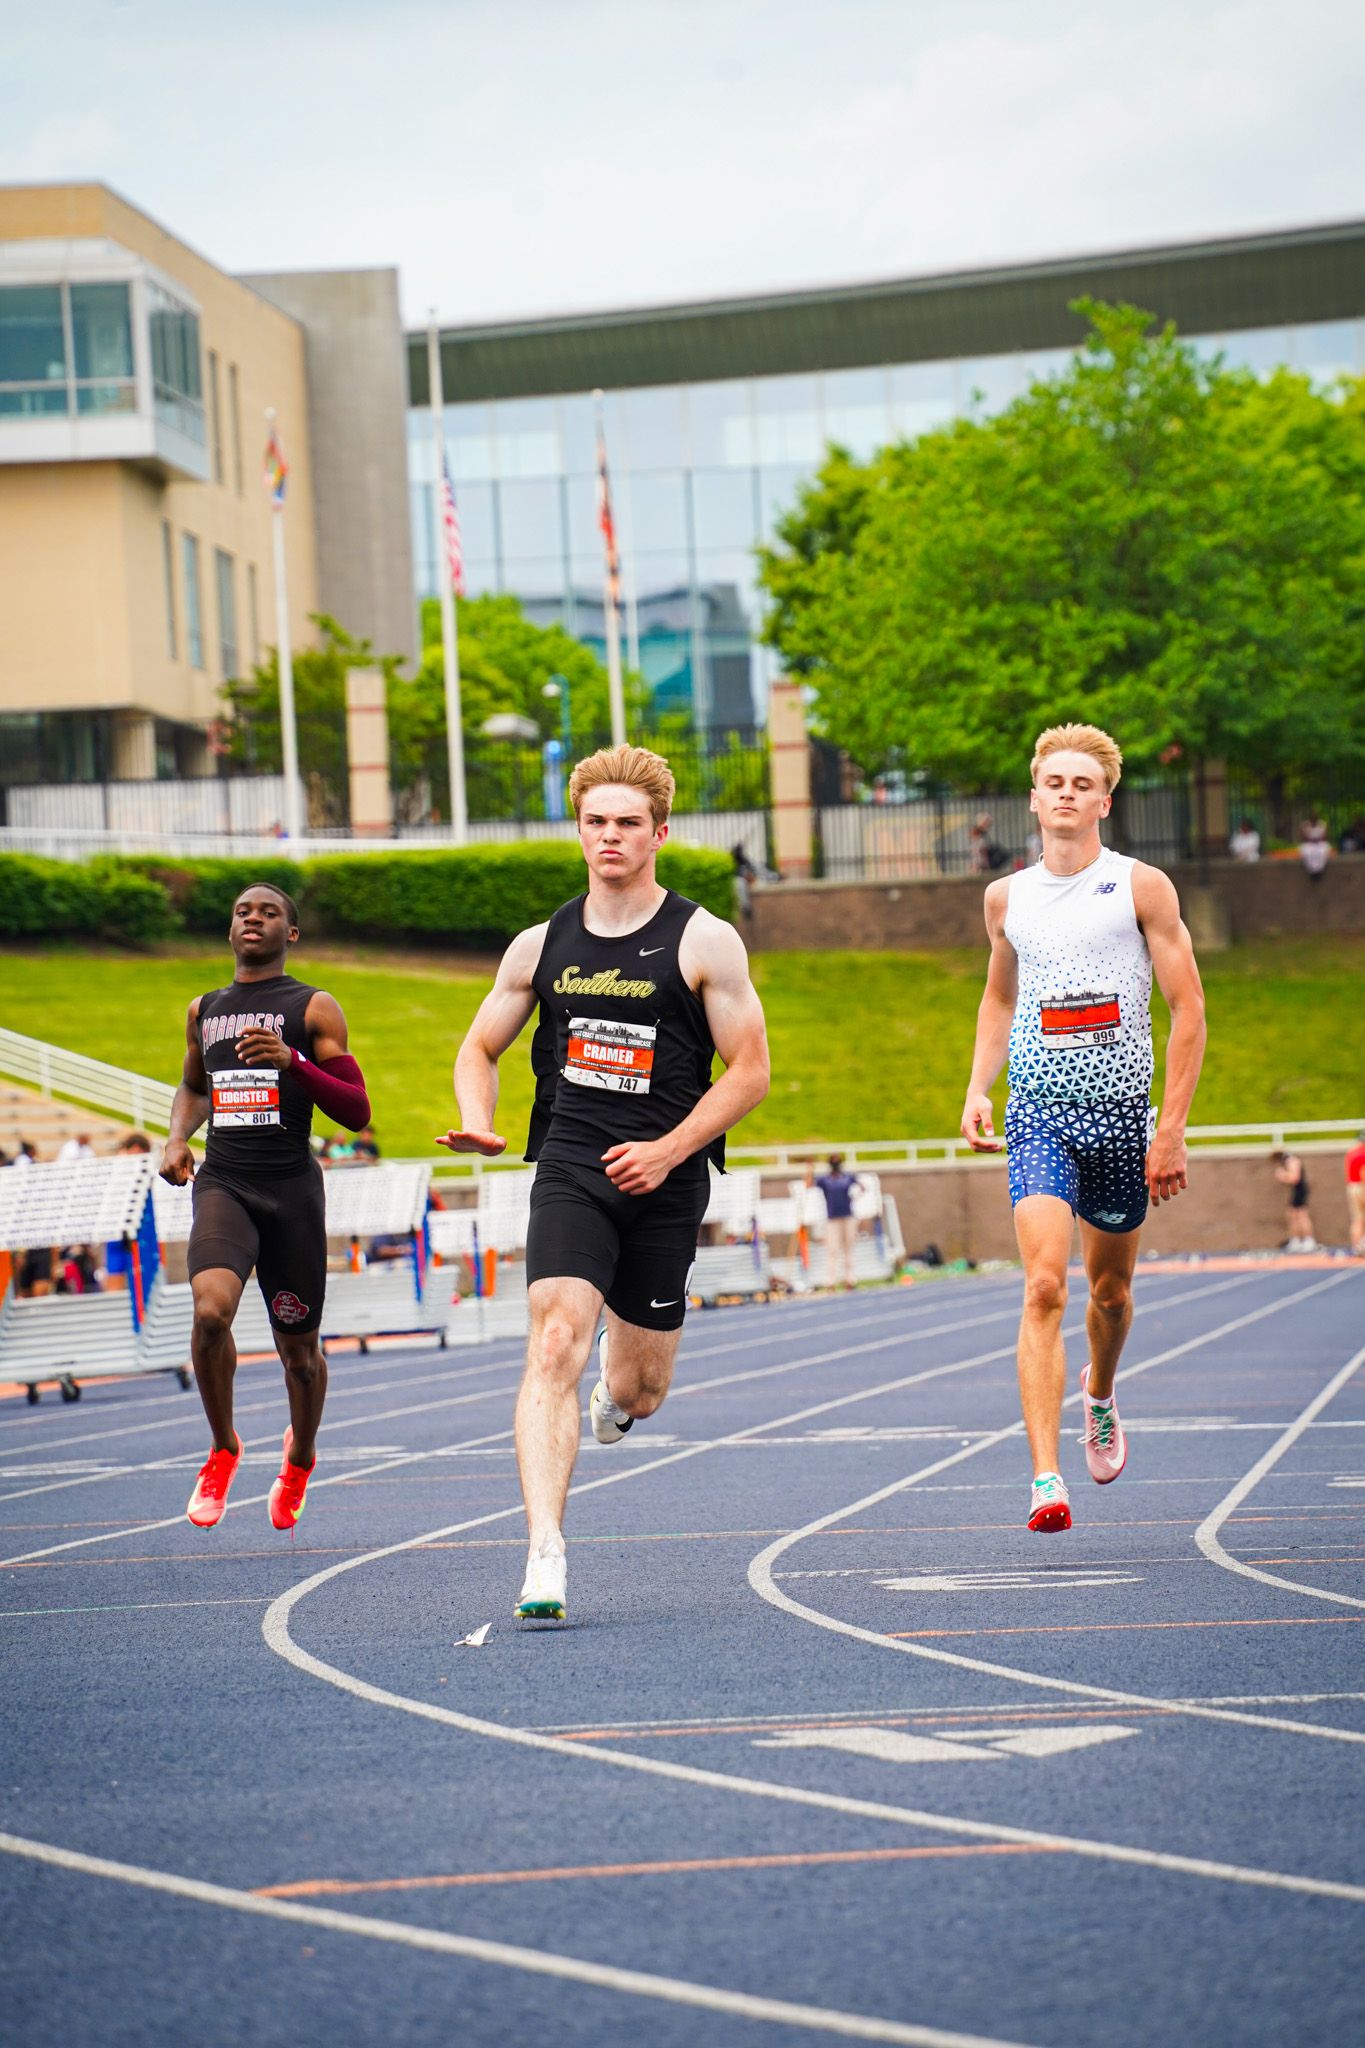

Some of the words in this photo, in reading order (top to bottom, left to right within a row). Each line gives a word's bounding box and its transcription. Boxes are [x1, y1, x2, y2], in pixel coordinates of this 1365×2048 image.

[553, 966, 656, 999] Southern
[1093, 1029, 1115, 1043] 999
[583, 1043, 634, 1064] CRAMER
[618, 1077, 638, 1091] 747
[219, 1090, 269, 1104] LEDGISTER
[252, 1113, 271, 1124] 801
